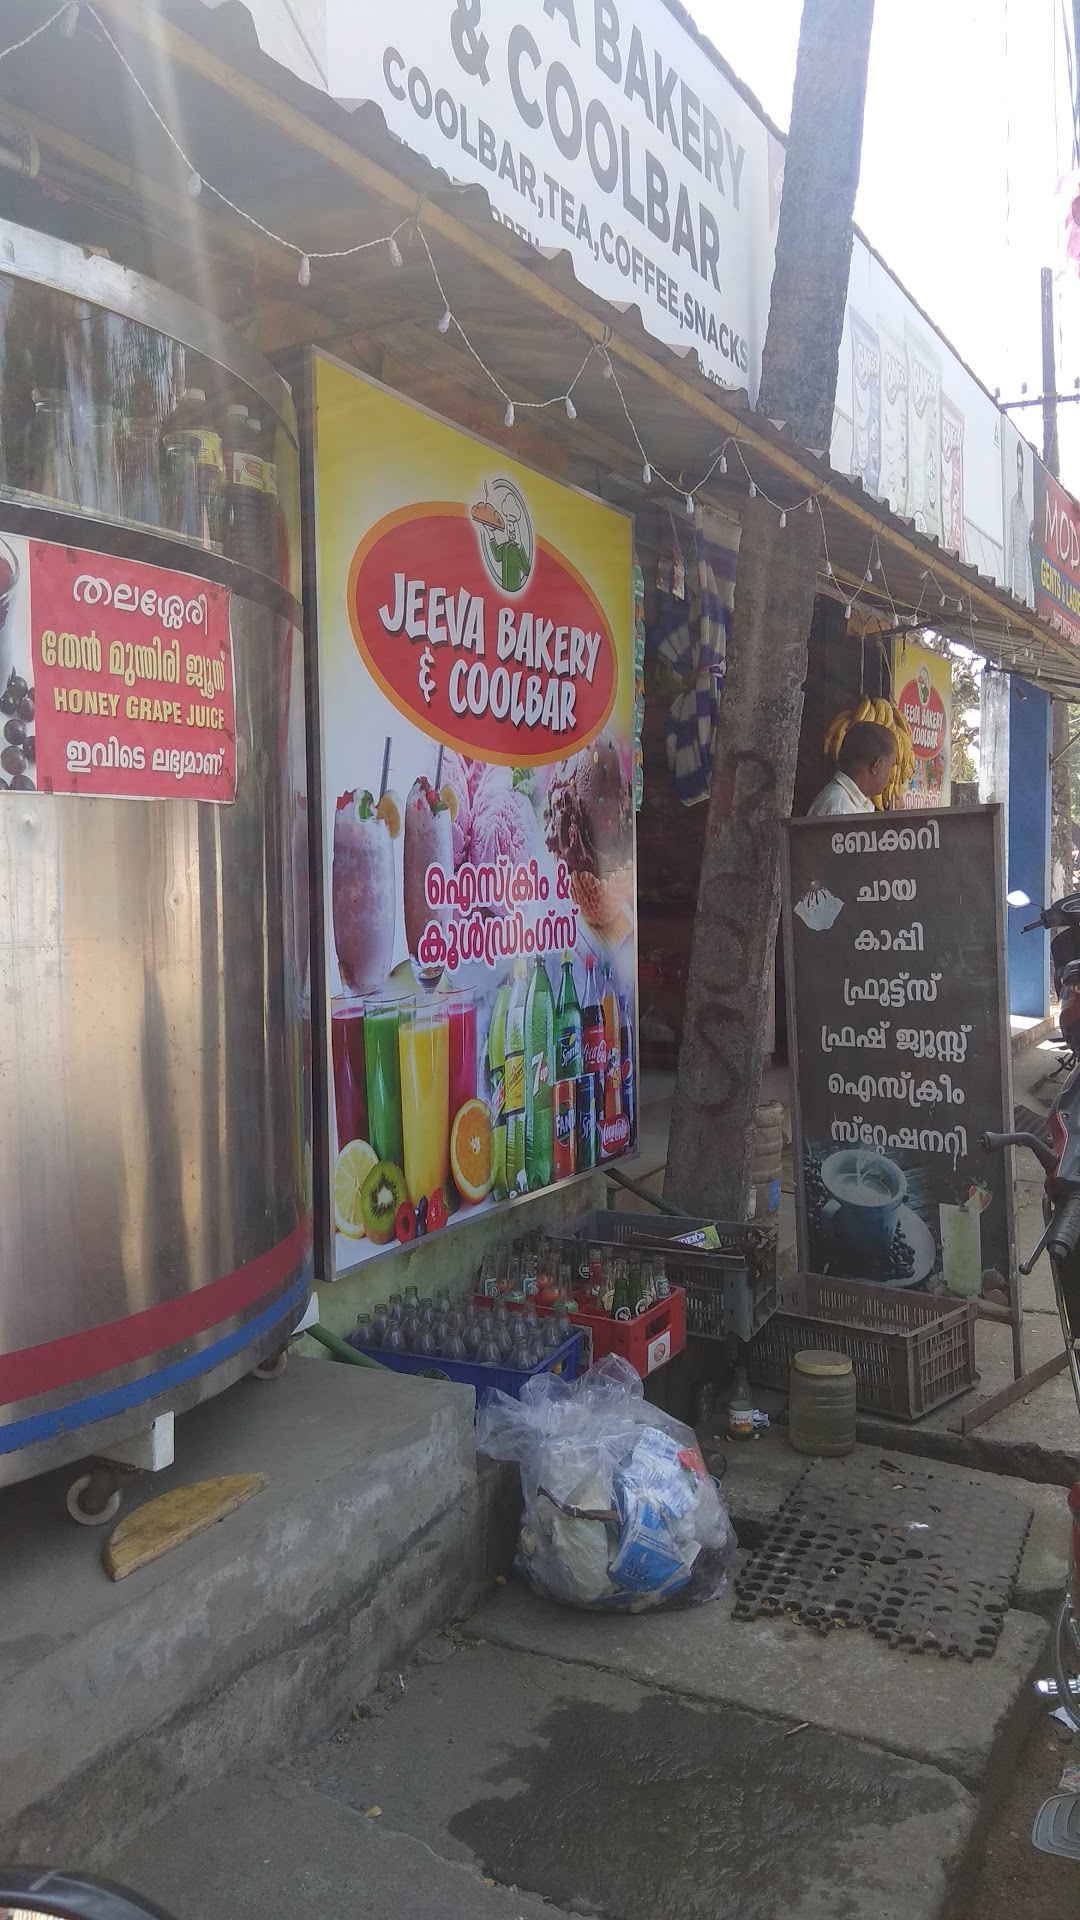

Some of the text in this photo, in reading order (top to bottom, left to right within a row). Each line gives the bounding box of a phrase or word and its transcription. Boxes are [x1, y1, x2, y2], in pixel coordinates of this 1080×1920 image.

[595, 0, 745, 211] BAKERY
[450, 0, 721, 293] & COOLBAR
[1041, 557, 1061, 600] GENTS
[73, 574, 208, 635] തലശ്ശേരി
[378, 572, 601, 683] JEEVA BAKERY
[41, 629, 102, 672] തേൻ
[109, 636, 180, 686] മുന്തിരി
[53, 687, 225, 729] HONEY GRAPE JUICE
[418, 646, 577, 731] & COOLBAR
[922, 709, 943, 731] BAKERY
[66, 735, 146, 773] ഇവിടെ
[831, 819, 940, 854] ബേക്കറി
[556, 862, 570, 899] &
[856, 877, 917, 902] ചായ
[854, 921, 924, 951] കാപ്പി
[821, 1020, 891, 1053] ഫ്രഷ്
